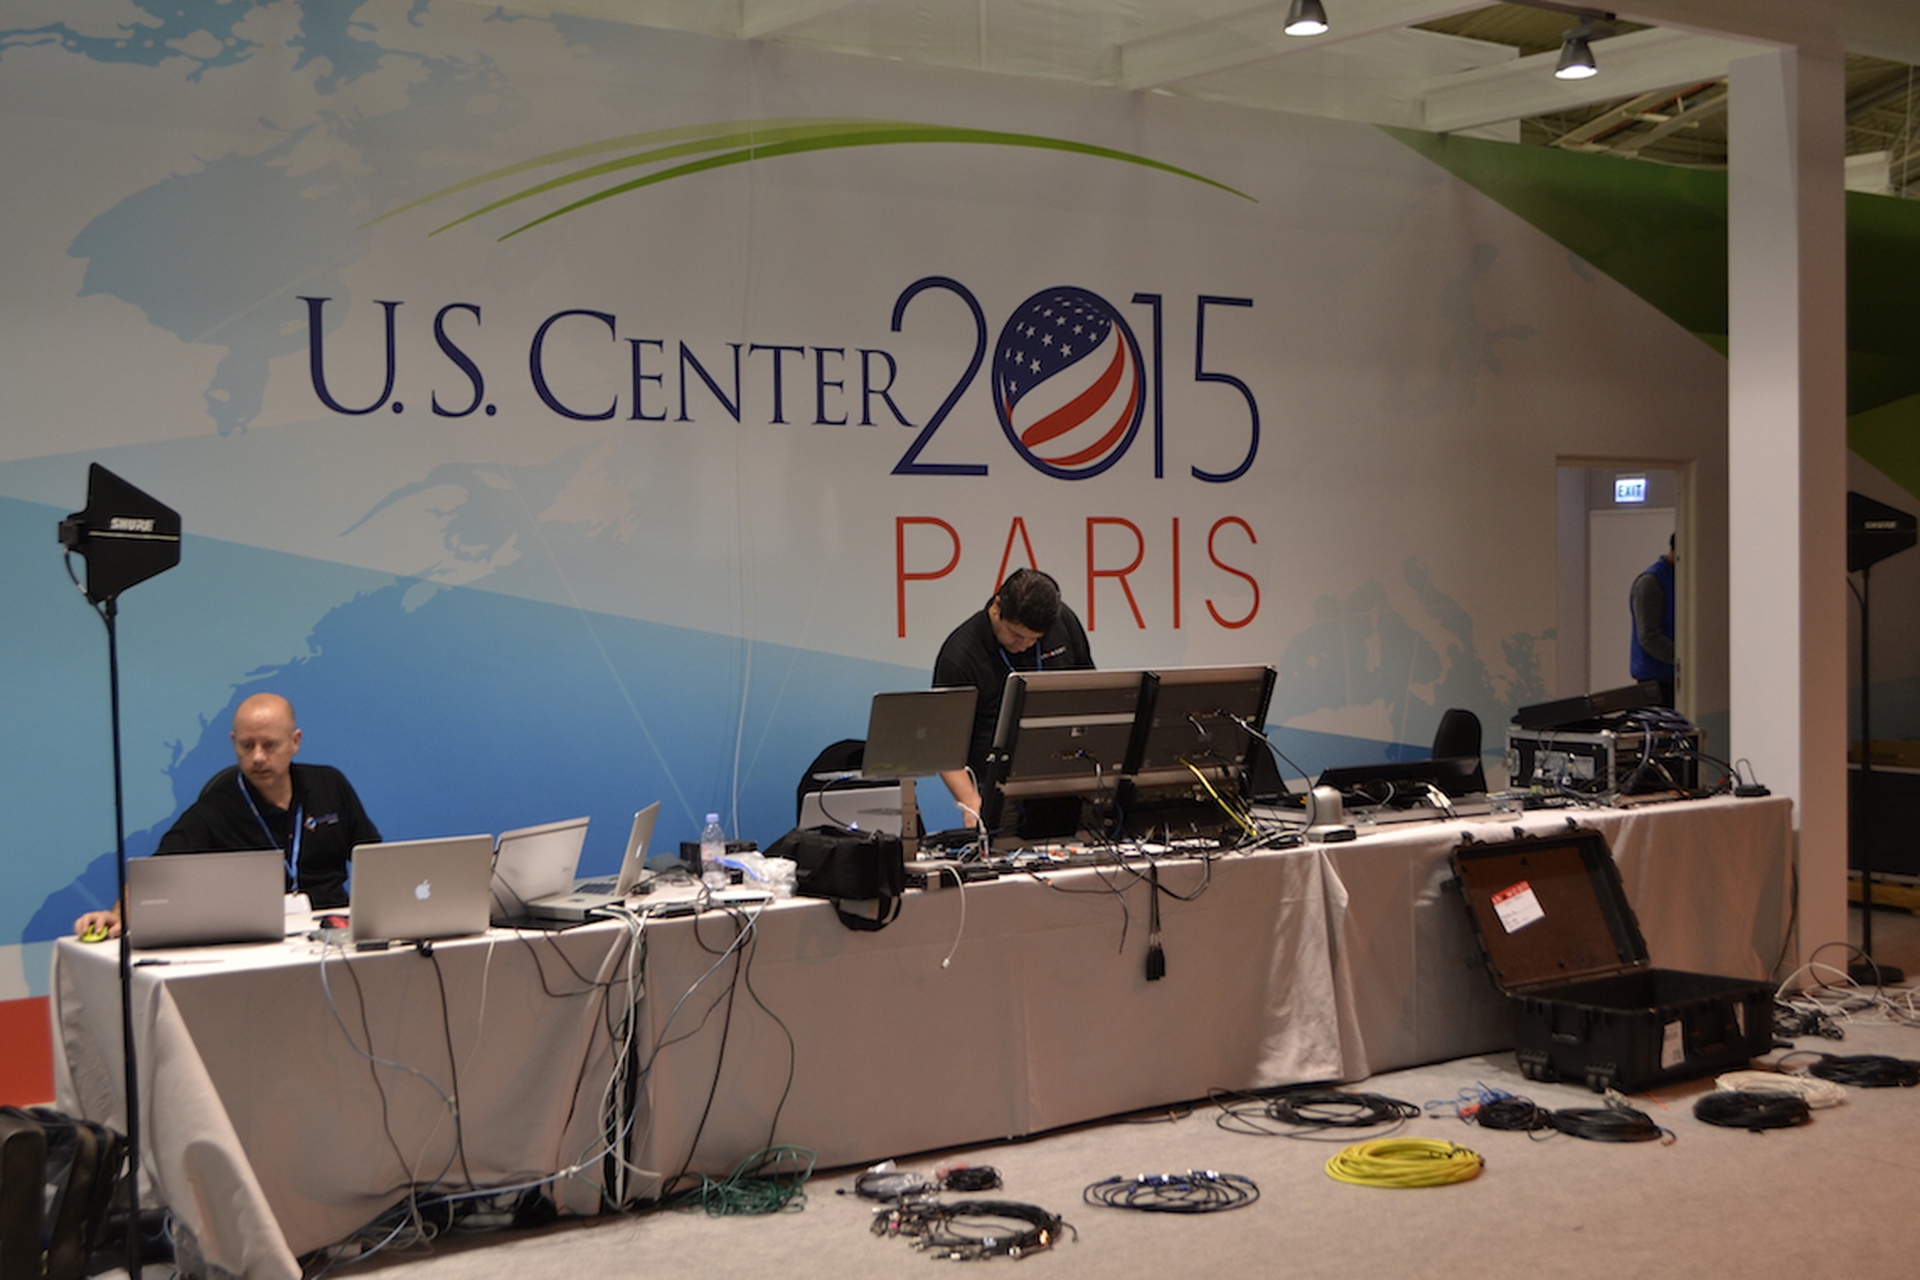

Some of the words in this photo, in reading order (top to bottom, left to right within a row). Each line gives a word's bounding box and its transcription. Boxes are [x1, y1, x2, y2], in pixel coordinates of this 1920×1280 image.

[296, 296, 497, 417] U.S.
[529, 309, 918, 427] CENTER
[890, 276, 1260, 483] 2015
[1618, 484, 1642, 498] EXIT
